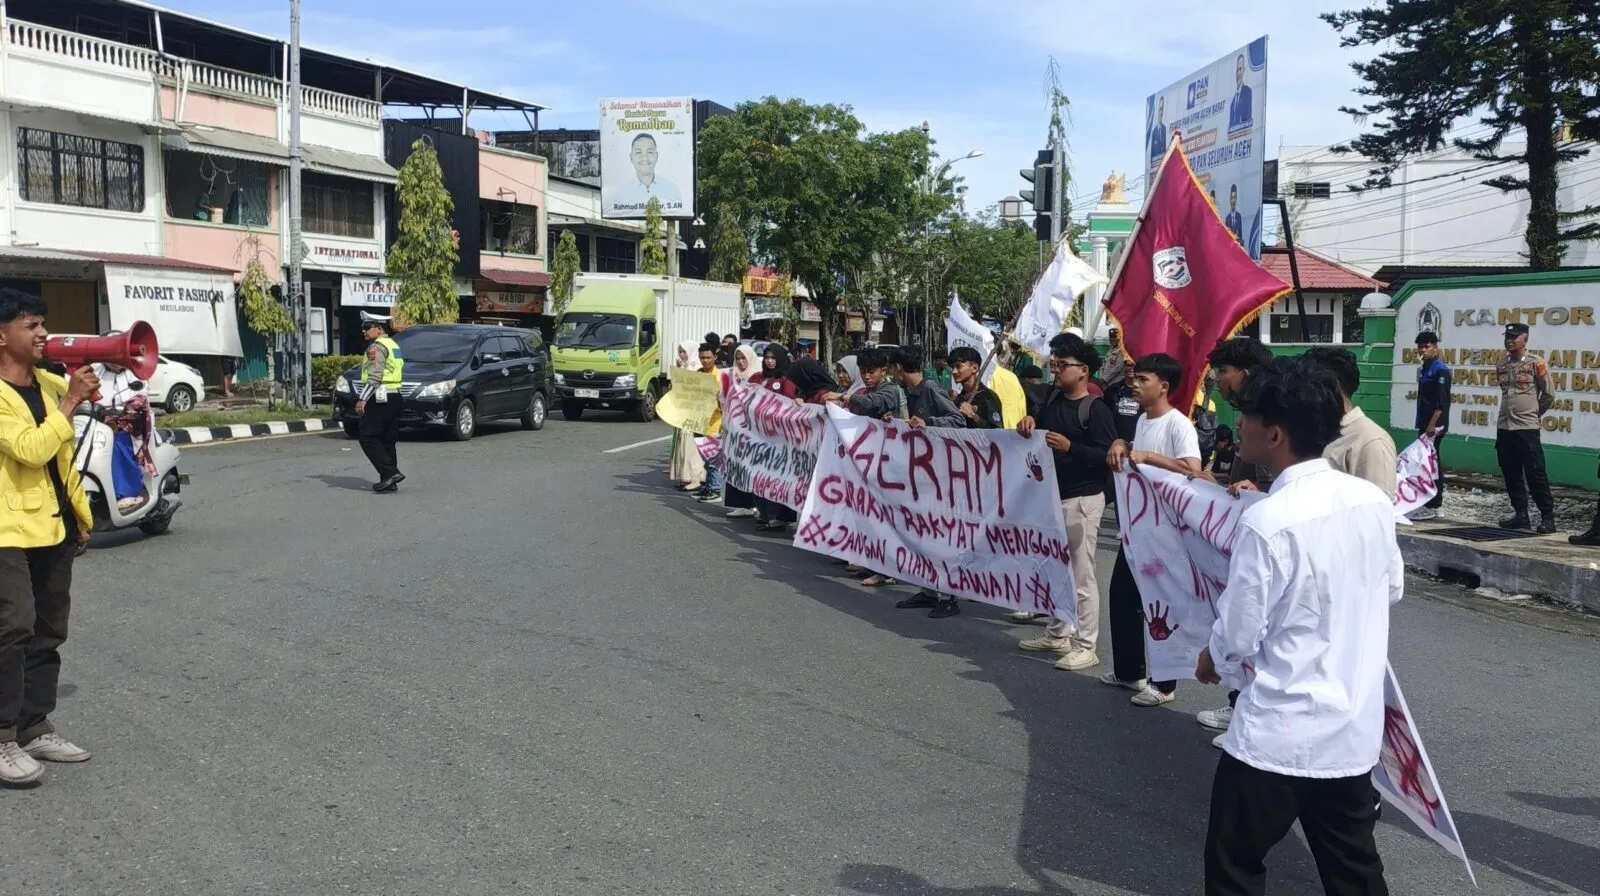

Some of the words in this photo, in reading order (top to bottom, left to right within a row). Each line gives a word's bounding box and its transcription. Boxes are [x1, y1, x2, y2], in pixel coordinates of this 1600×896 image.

[1196, 75, 1209, 91] PAN
[616, 118, 675, 132] Ramadhan
[1234, 138, 1252, 158] ACEH
[314, 246, 380, 260] INTERNATIONAL
[124, 284, 177, 301] FAVORIT
[178, 286, 225, 304] FASHION
[159, 305, 195, 313] MEULABOH
[1454, 305, 1596, 327] KANTOR
[1402, 348, 1456, 364] DEAN
[900, 504, 980, 552] RAKYAT
